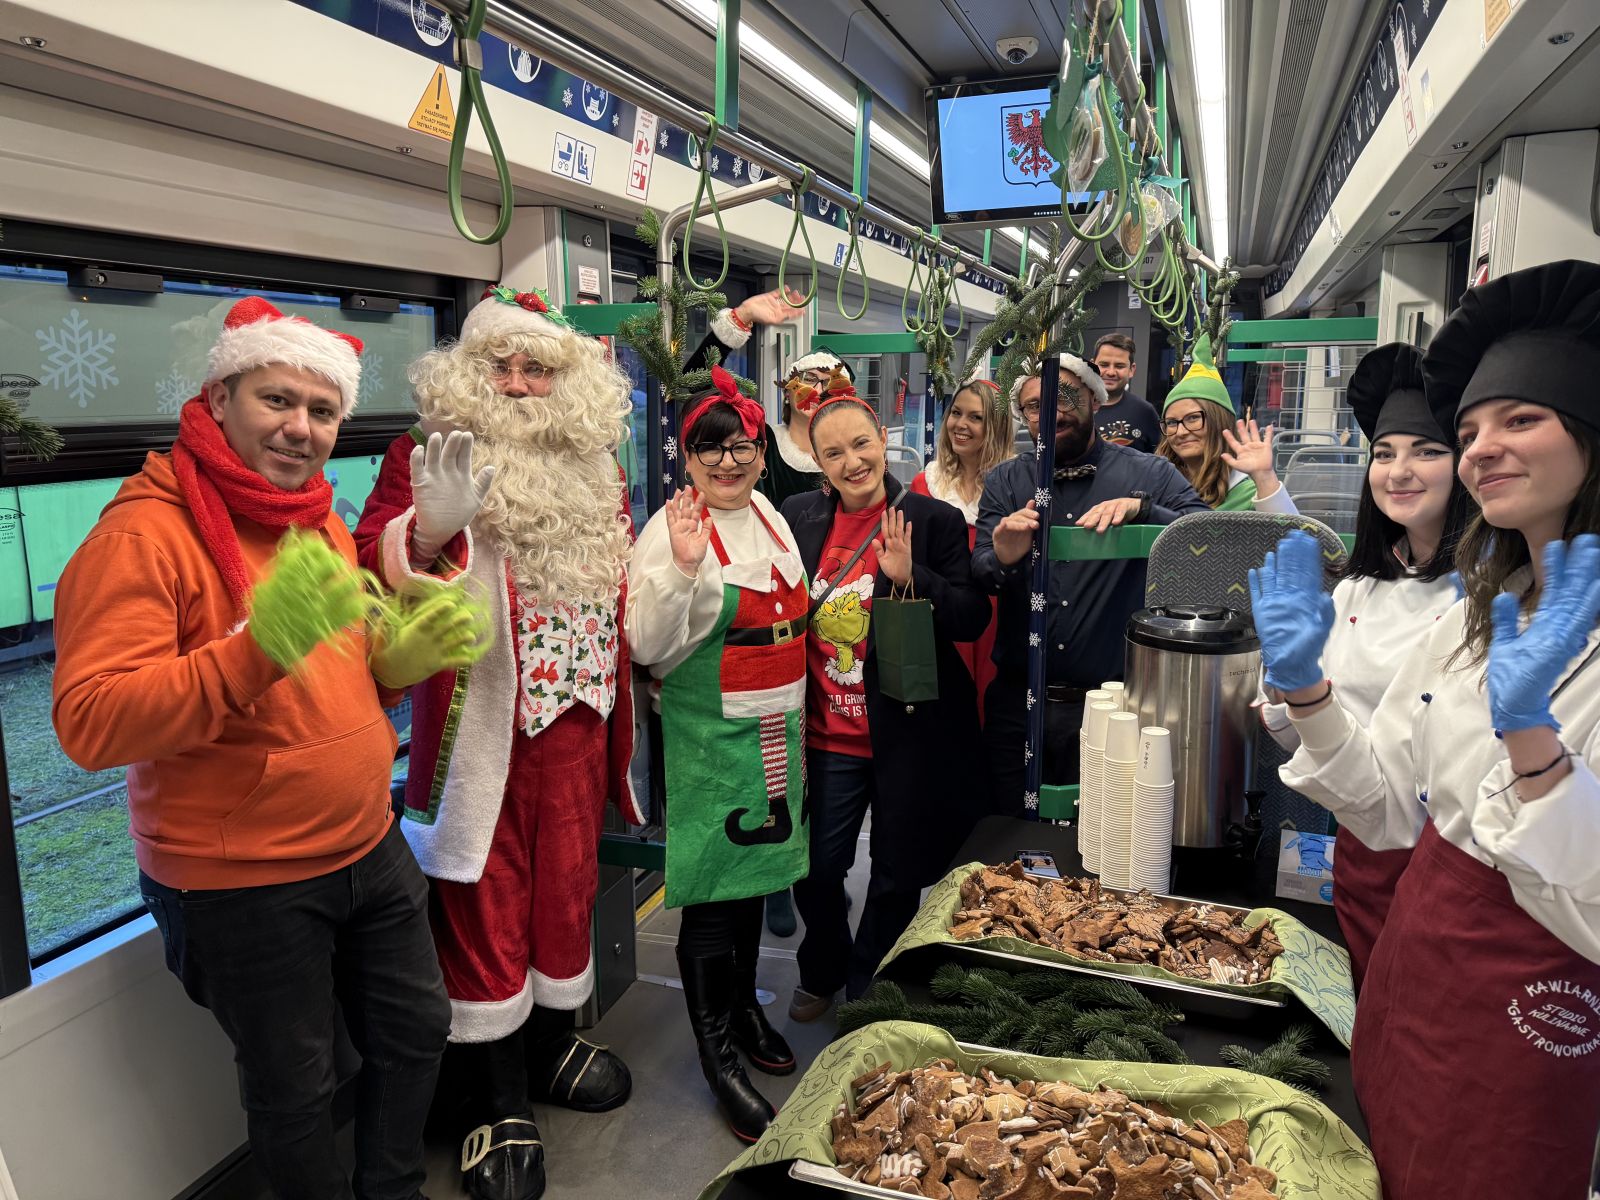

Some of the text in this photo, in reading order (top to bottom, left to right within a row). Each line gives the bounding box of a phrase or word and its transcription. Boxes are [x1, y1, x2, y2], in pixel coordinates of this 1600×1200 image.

[852, 705, 863, 717] IS
[1527, 1009, 1591, 1037] KULINARNE
[1541, 1003, 1587, 1024] STUDIO
